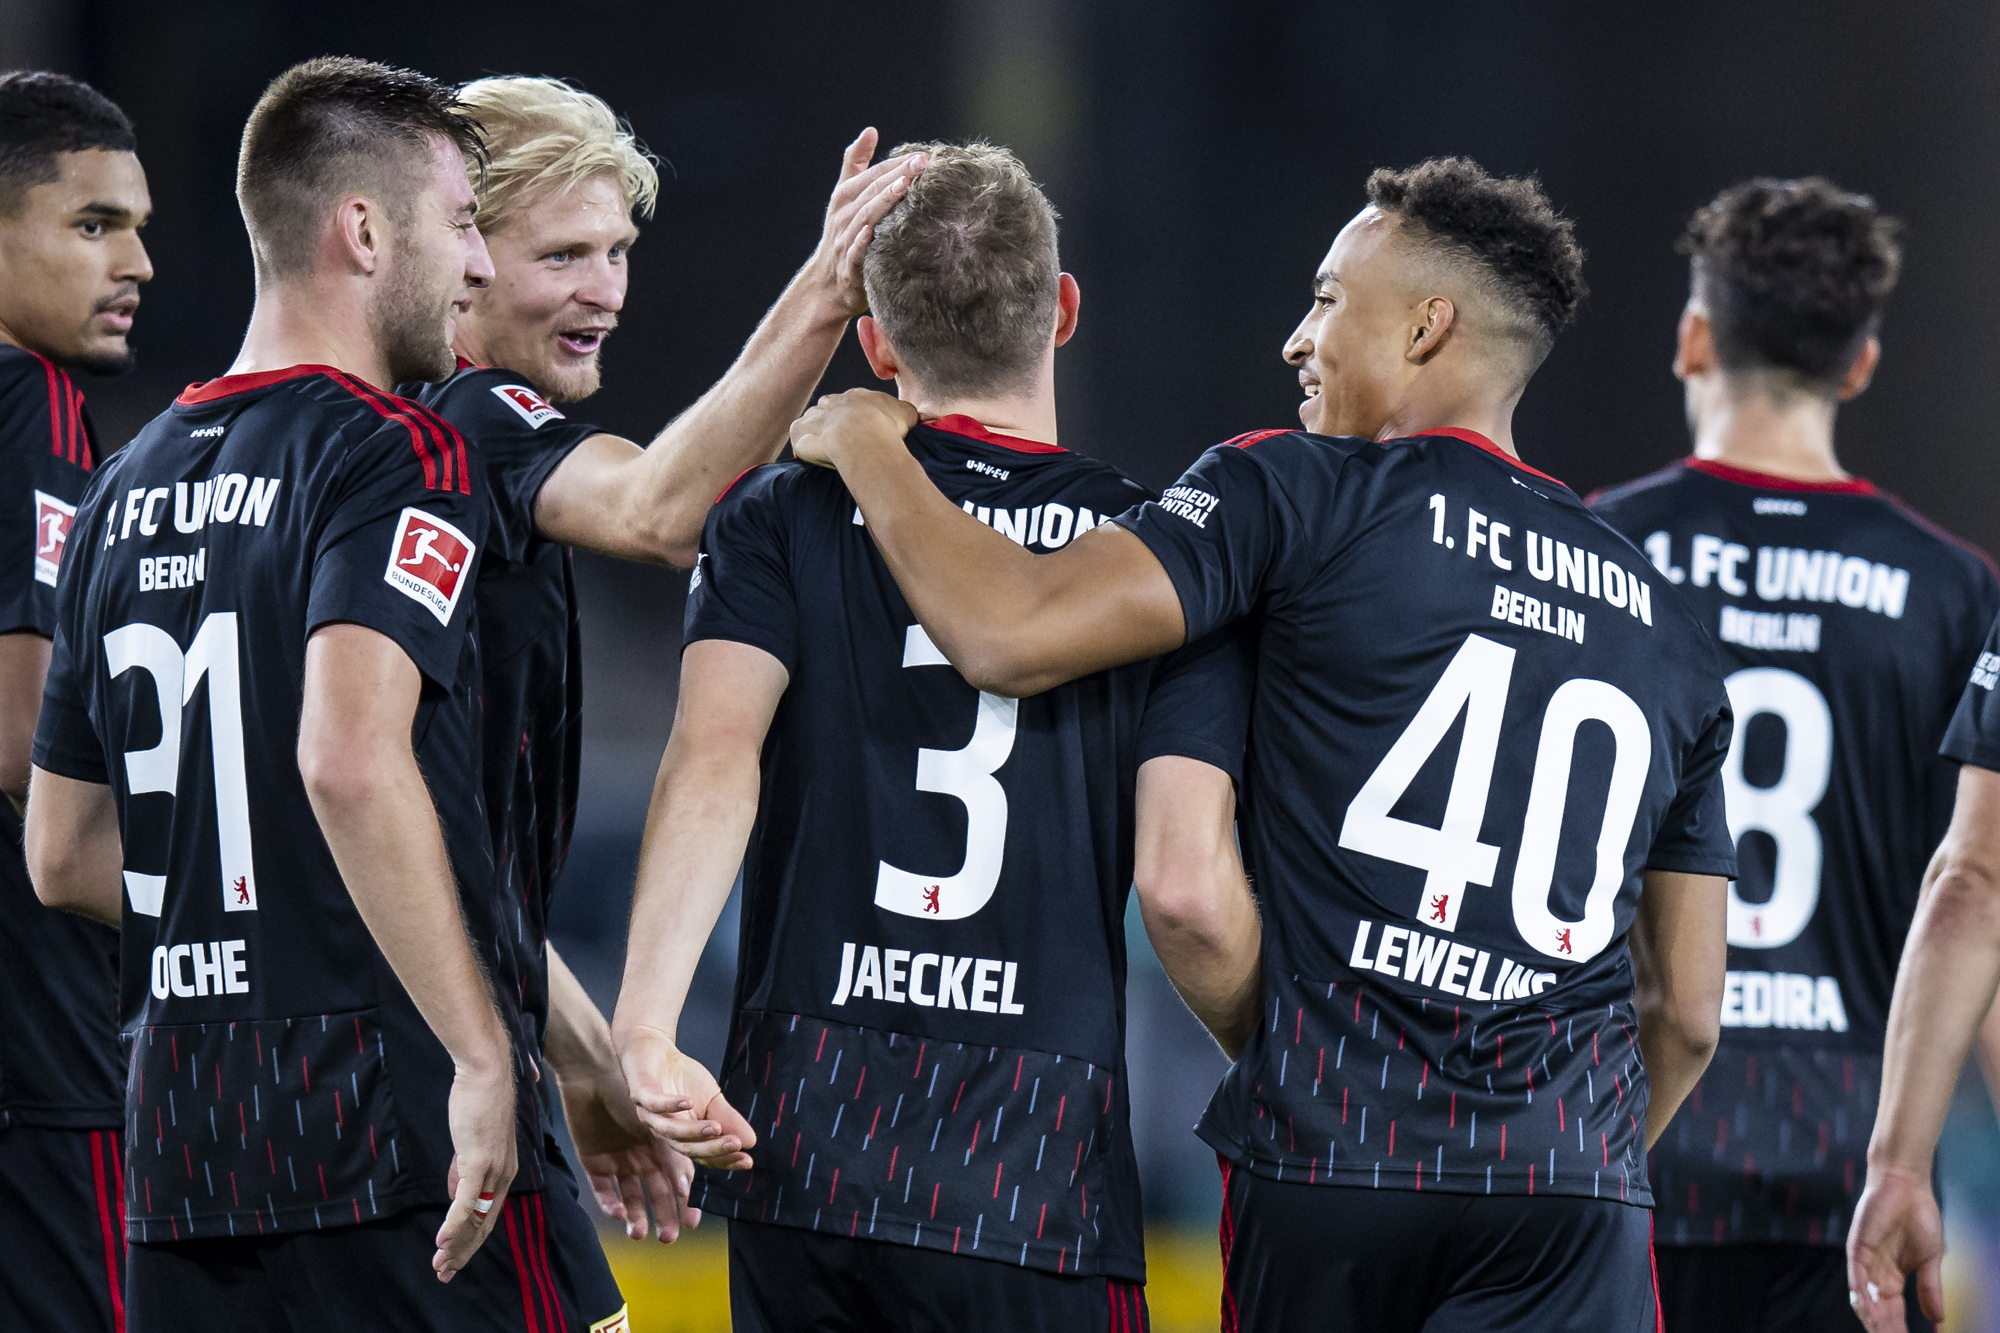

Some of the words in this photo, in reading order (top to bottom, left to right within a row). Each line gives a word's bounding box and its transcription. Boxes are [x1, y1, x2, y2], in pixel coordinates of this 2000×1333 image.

[120, 487, 170, 540] FC
[173, 472, 281, 534] UNION
[391, 570, 447, 615] BUNDESLIGA
[1429, 493, 1456, 550] 1.
[1466, 507, 1512, 571] FC
[1526, 531, 1653, 627] UNION
[1644, 530, 1686, 585] 1.
[1691, 533, 1750, 597] FC
[1755, 546, 1911, 620] UNION
[1490, 584, 1586, 645] BERLIN
[1719, 604, 1822, 653] BERLIN
[103, 612, 258, 917] 31
[874, 624, 1019, 920] 3
[1337, 633, 1652, 964] 40
[1723, 666, 1834, 949] 8
[151, 939, 250, 1000] OCHE
[831, 942, 1025, 1015] JAECKEL
[1719, 970, 1849, 1033] EDIRA
